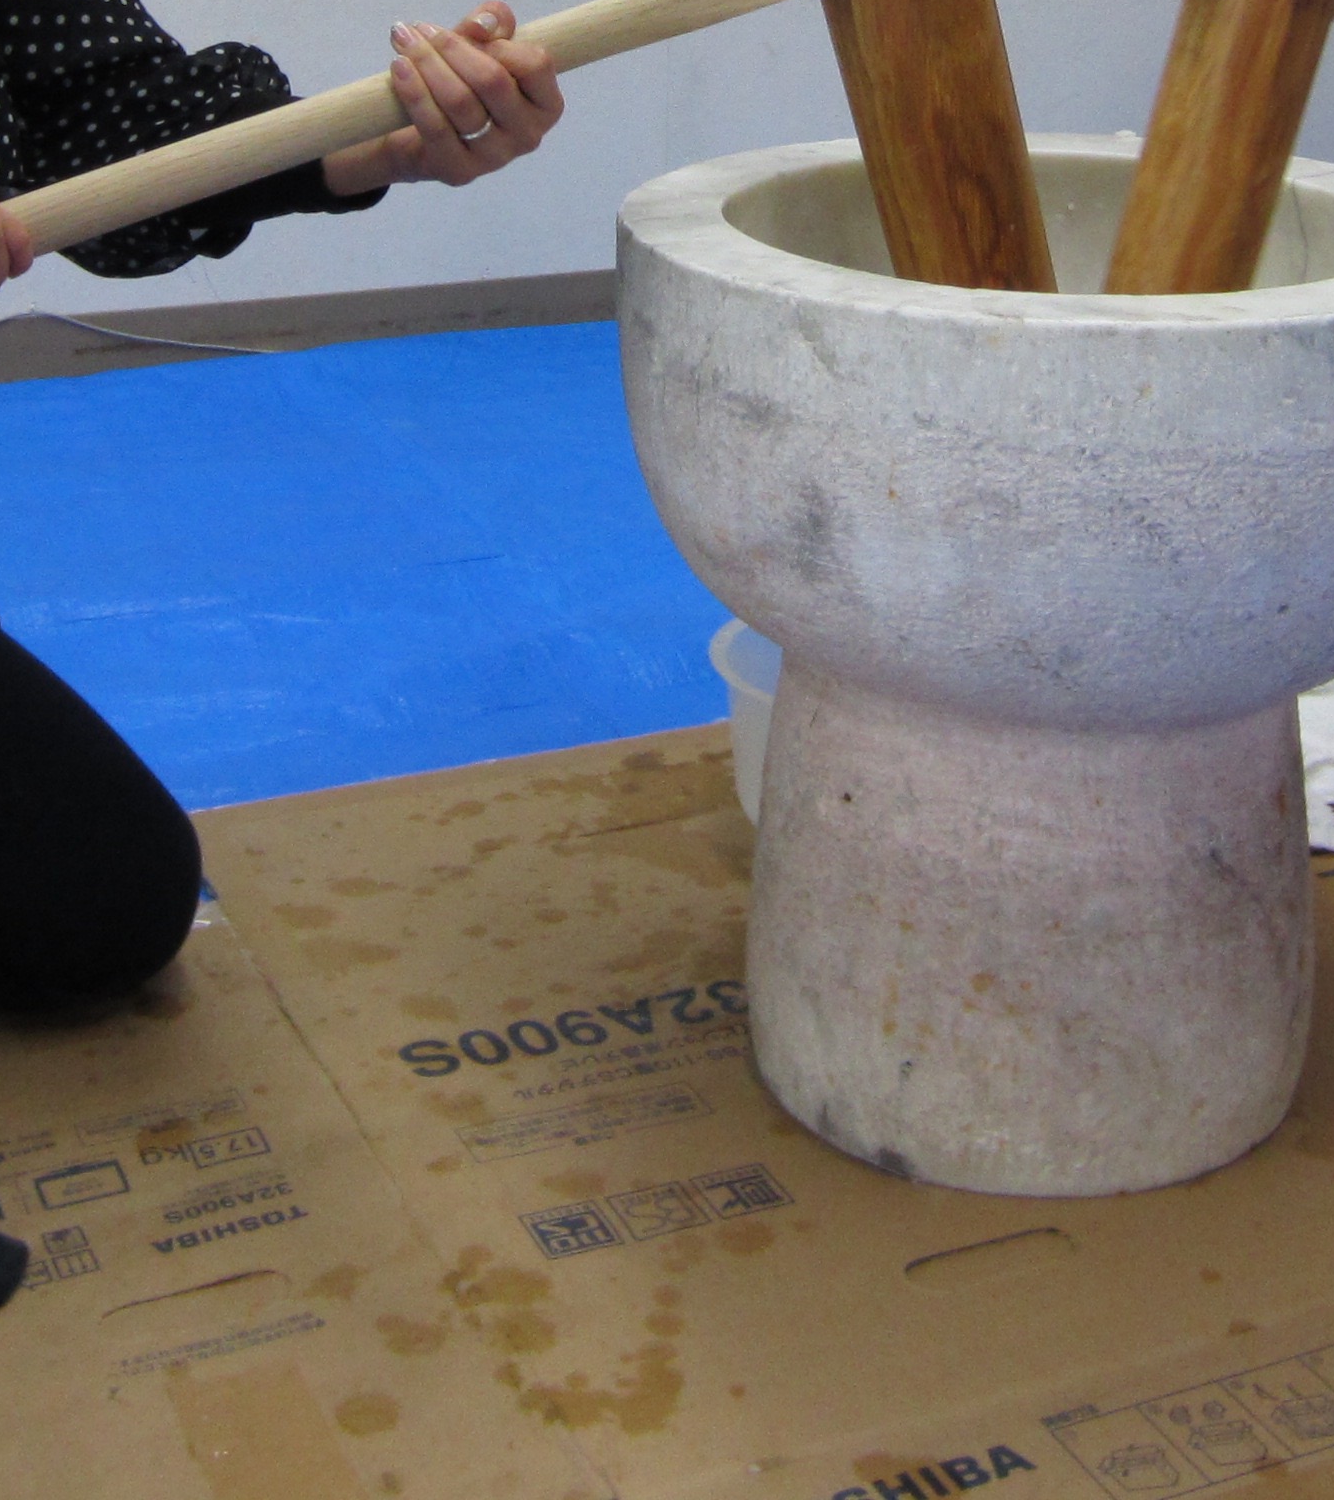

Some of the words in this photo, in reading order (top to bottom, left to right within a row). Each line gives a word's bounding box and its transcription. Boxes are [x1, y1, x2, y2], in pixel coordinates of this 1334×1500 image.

[398, 980, 749, 1077] 32A900S
[198, 1133, 259, 1160] 17.5
[163, 1182, 293, 1224] 32A900S
[151, 1205, 309, 1254] TOSHIBA
